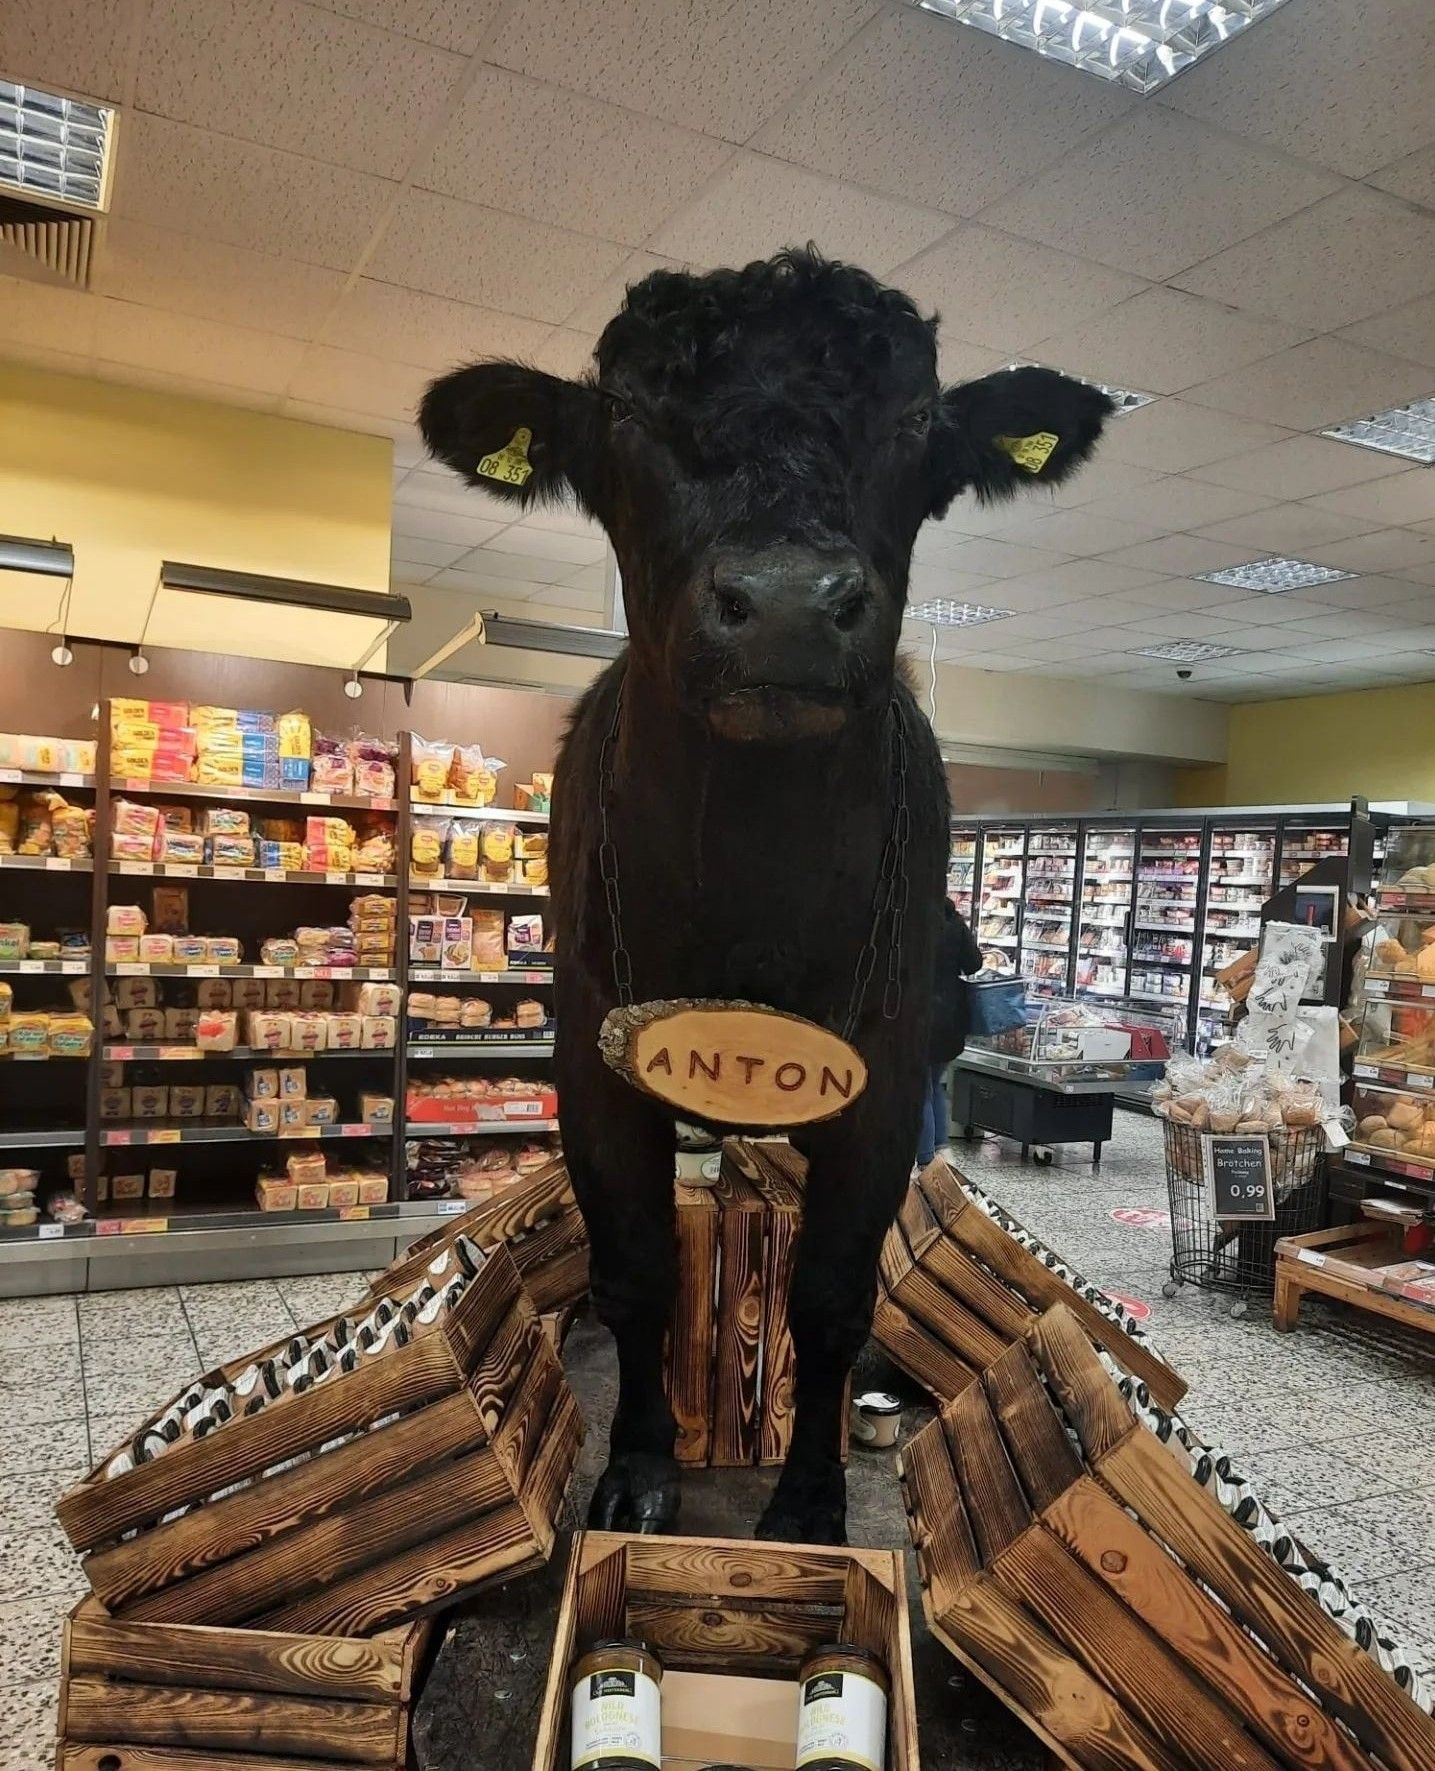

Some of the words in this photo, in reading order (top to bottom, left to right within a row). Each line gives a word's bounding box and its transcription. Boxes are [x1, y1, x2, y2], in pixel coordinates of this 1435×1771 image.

[479, 458, 500, 476] 08
[503, 465, 529, 485] 351
[646, 1047, 853, 1099] ANTON
[1237, 1147, 1263, 1156] Baking
[1230, 1184, 1265, 1199] 0,99
